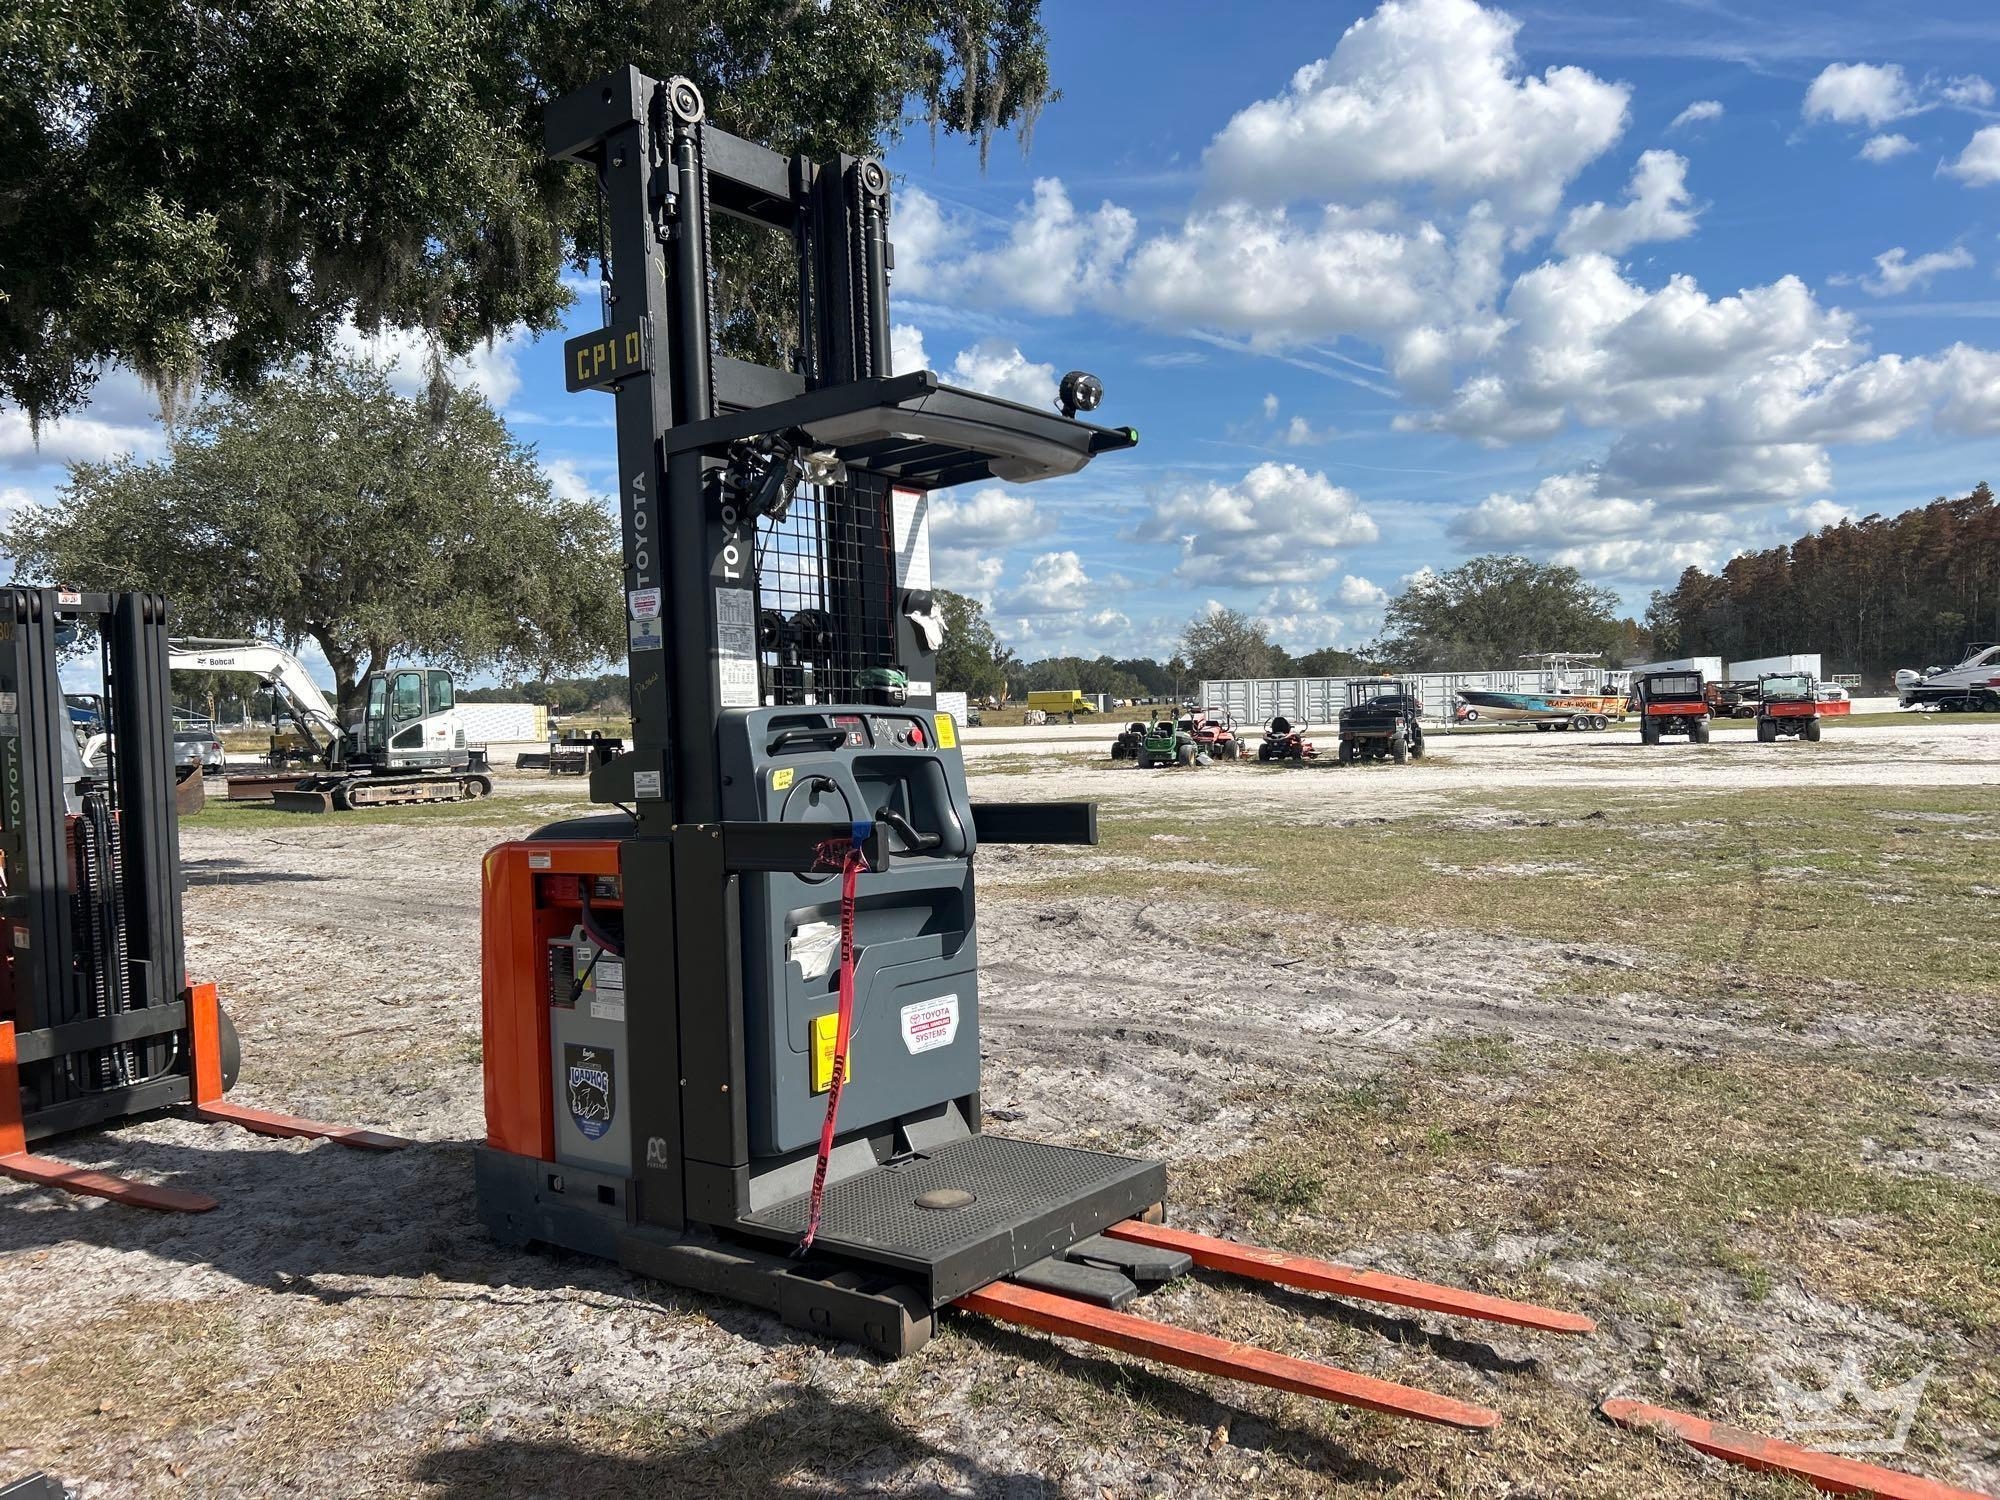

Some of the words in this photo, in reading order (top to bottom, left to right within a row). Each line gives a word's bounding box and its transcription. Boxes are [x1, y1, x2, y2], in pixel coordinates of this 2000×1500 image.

[631, 470, 650, 589] TOYOTA
[209, 658, 235, 666] Bobcat
[6, 737, 21, 829] TOYOTA
[921, 1007, 950, 1021] TOYOTA
[915, 1027, 947, 1043] SYSTEMS
[569, 1066, 609, 1094] LOADHOG
